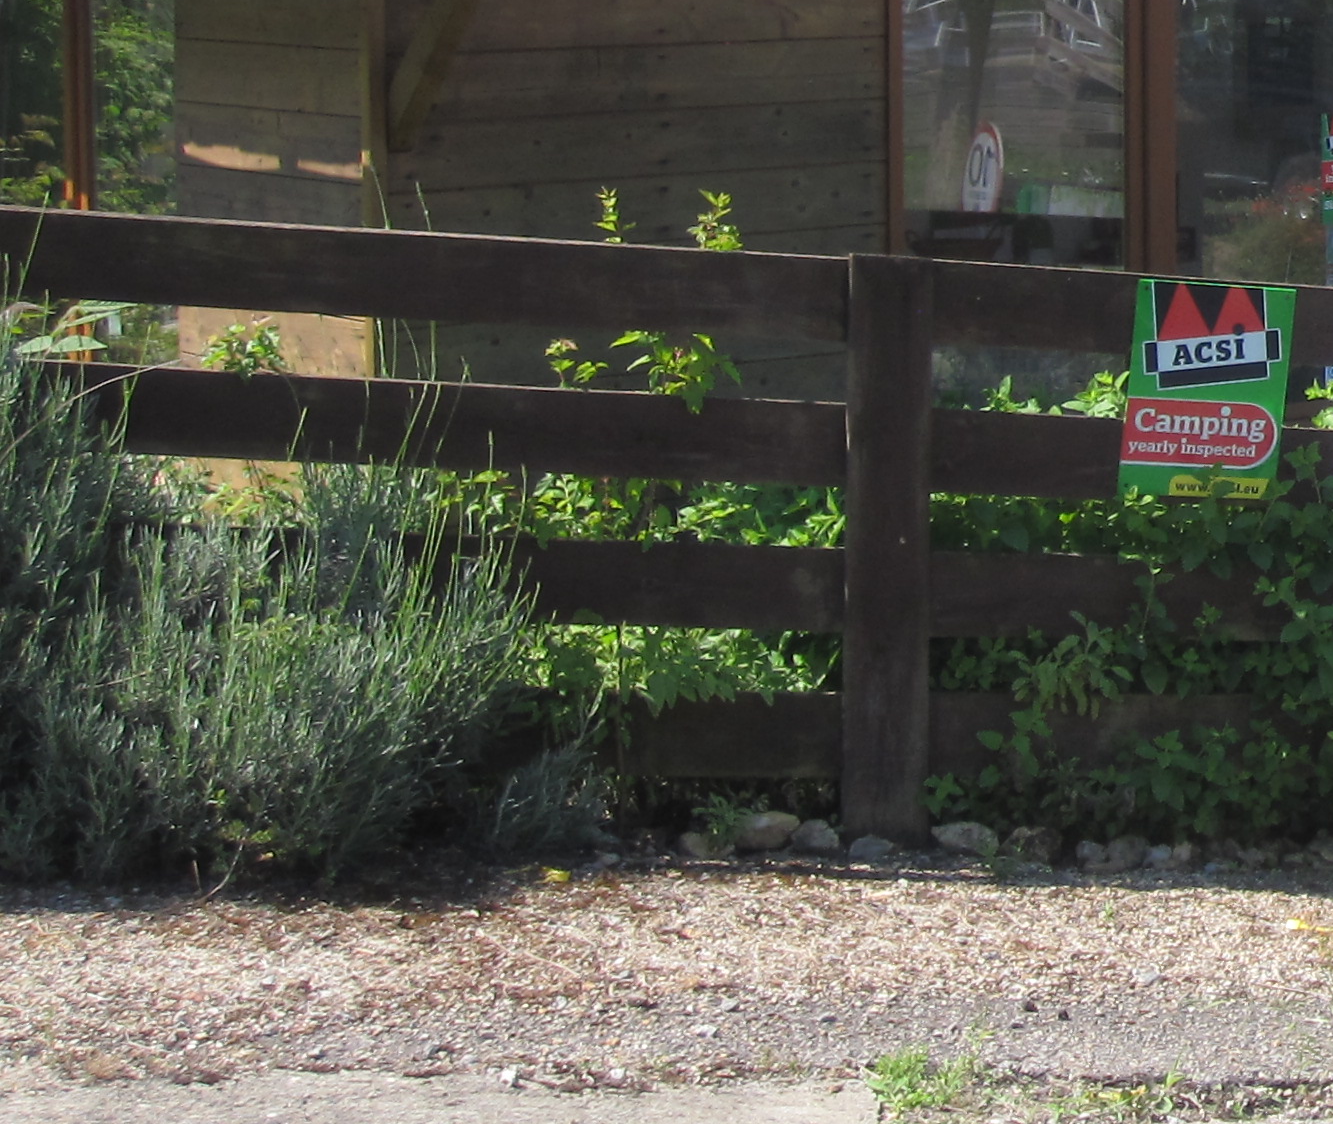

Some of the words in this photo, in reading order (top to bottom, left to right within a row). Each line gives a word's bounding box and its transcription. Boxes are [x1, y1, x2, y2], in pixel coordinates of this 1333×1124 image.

[1172, 338, 1245, 366] ACSI
[1134, 406, 1267, 443] Camping
[1128, 439, 1178, 456] yearly
[1180, 438, 1256, 458] inspected
[1175, 481, 1259, 495] www.i.eu
